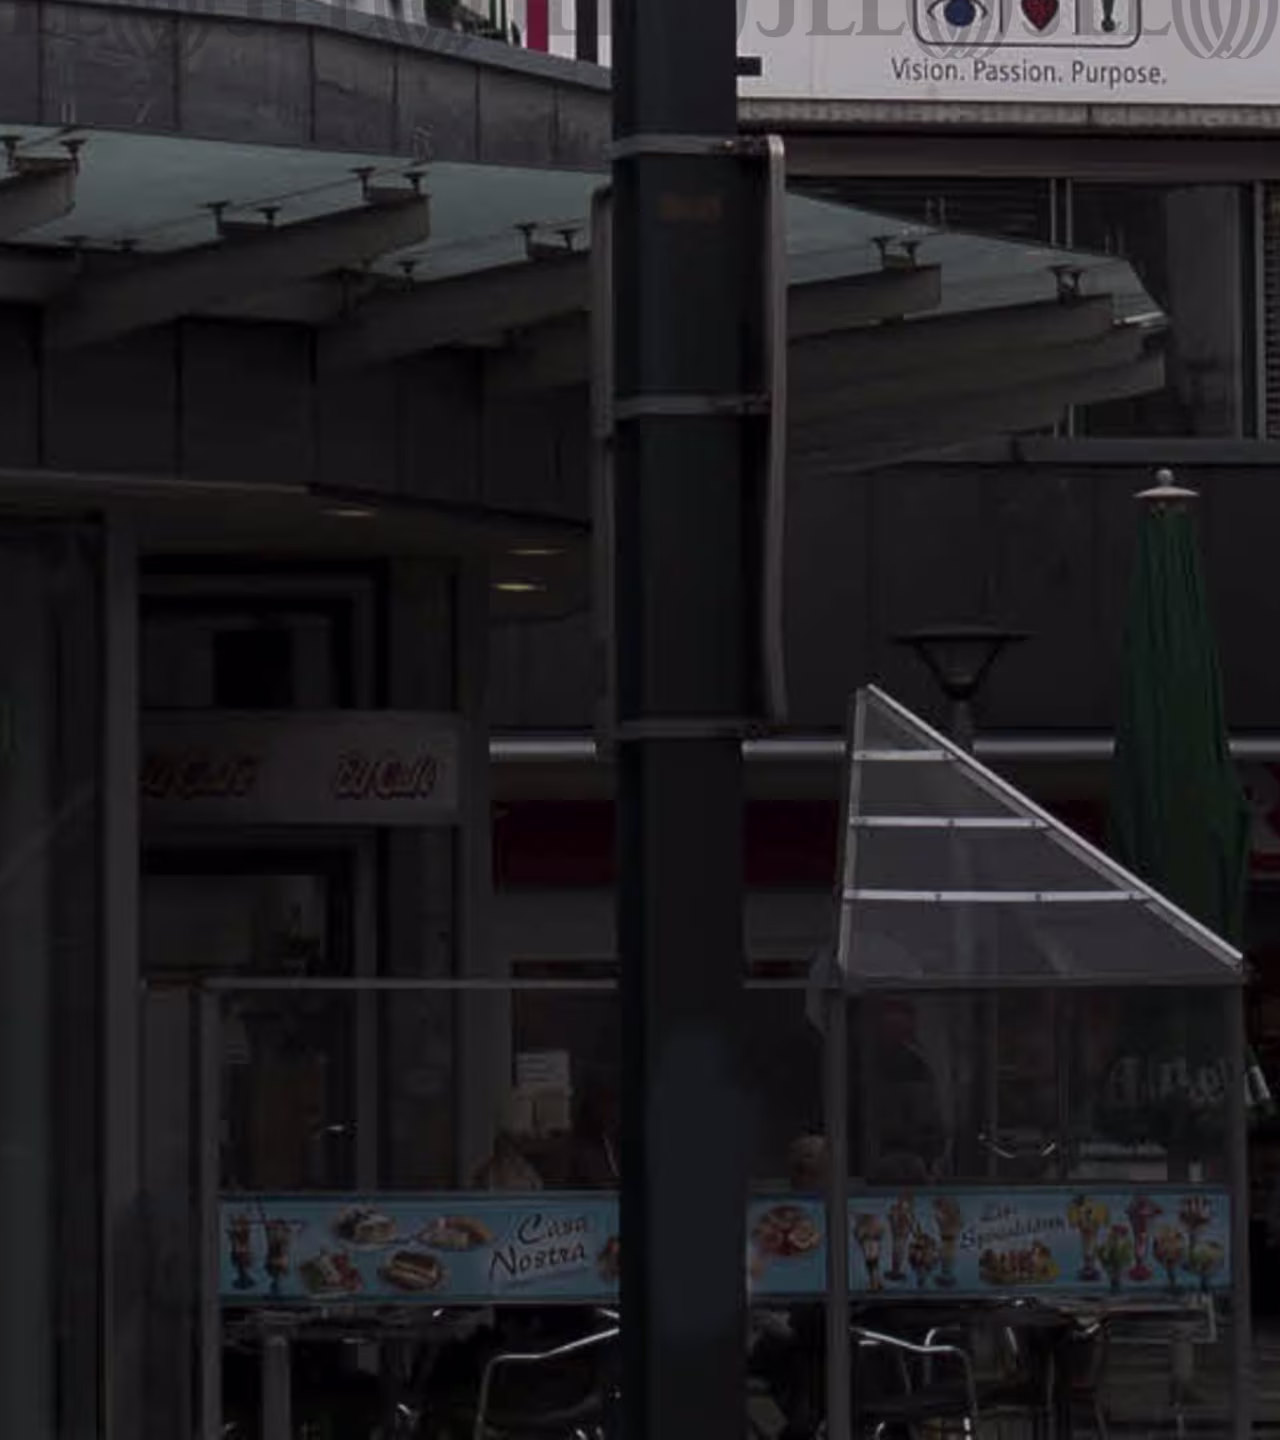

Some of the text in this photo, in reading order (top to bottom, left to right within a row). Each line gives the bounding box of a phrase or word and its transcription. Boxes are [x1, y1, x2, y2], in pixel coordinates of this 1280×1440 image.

[891, 56, 1168, 91] Vision. Passion. Purpose.
